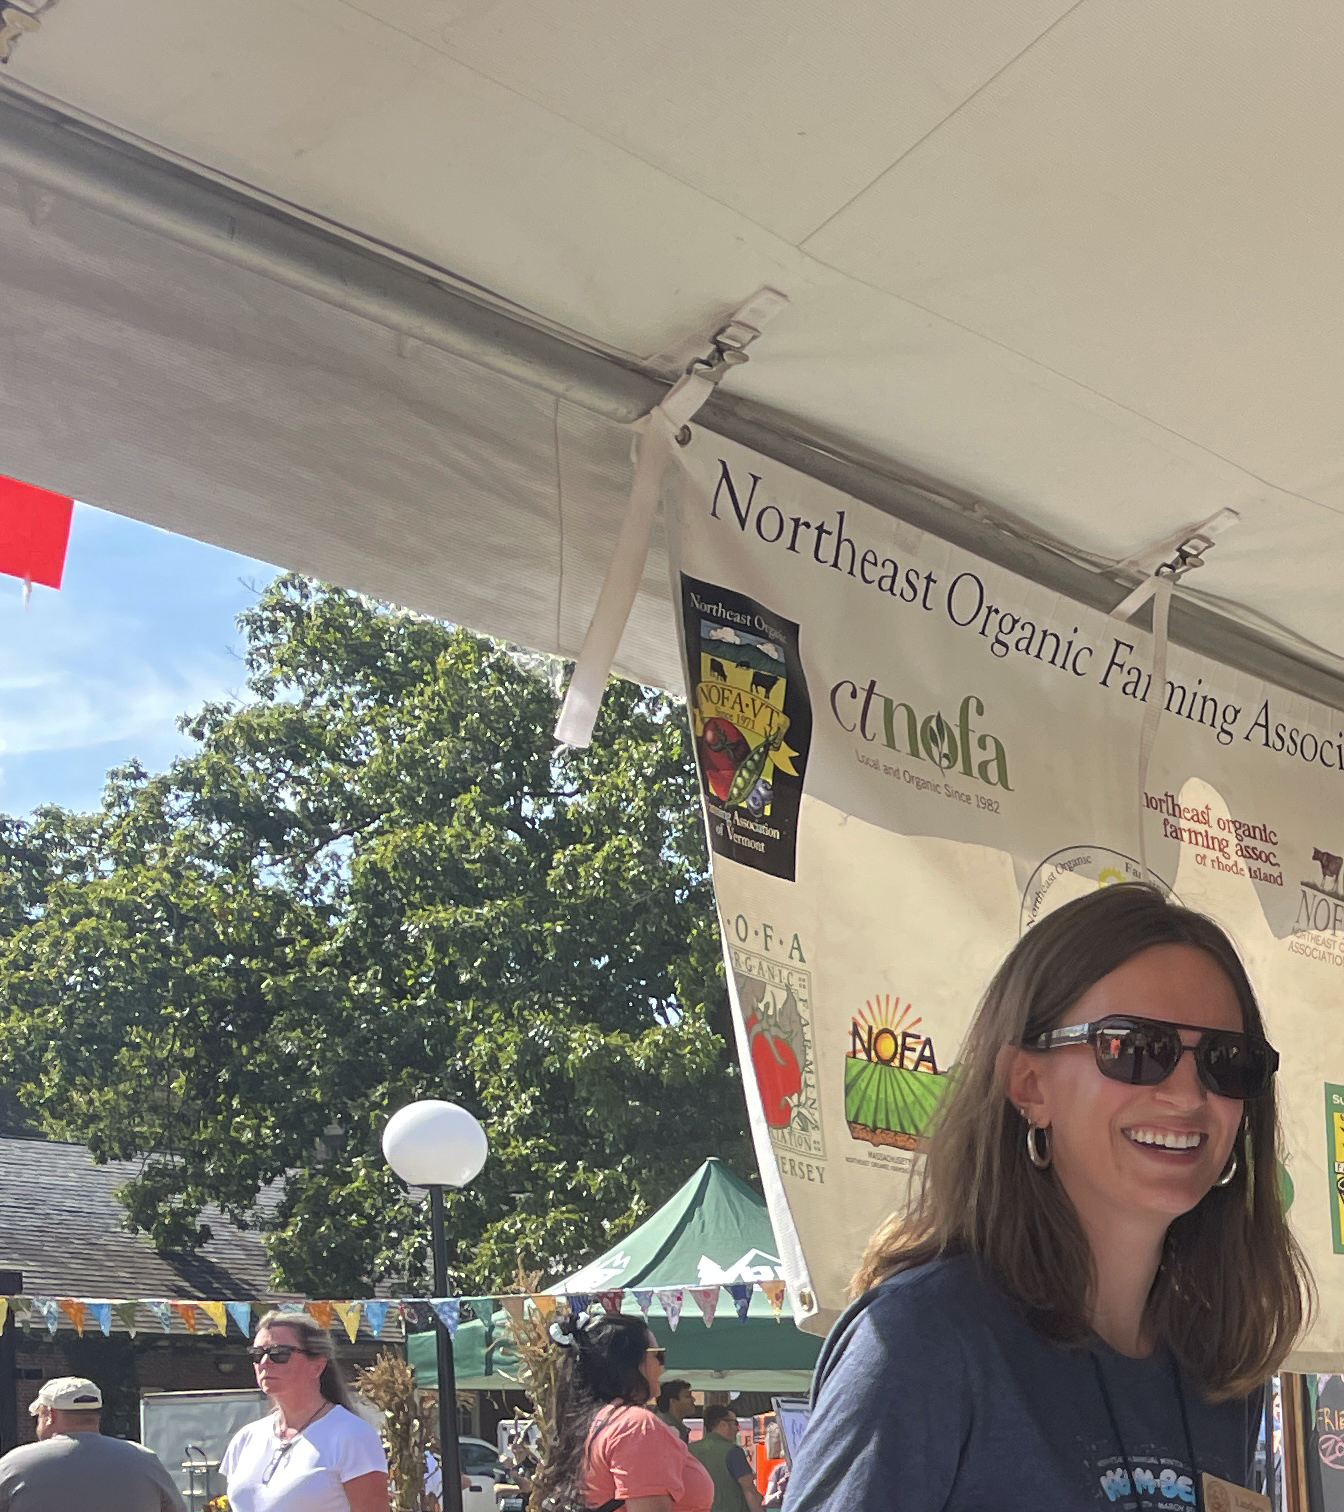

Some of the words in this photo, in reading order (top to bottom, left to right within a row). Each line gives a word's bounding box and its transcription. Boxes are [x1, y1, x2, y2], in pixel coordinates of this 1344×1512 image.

[710, 458, 938, 611] Northeast
[947, 572, 1093, 678] Organic
[690, 591, 751, 627] Northeast
[830, 679, 1015, 792] ctnofa
[883, 763, 901, 781] and
[903, 769, 942, 796] Organic
[944, 782, 972, 806] Since
[974, 793, 1001, 815] 1982
[726, 819, 766, 853] Vermont
[733, 810, 781, 840] Association
[1163, 817, 1229, 860] farming
[1217, 815, 1280, 846] organic
[1195, 852, 1208, 867] of
[1211, 856, 1246, 877] rhode
[1026, 871, 1058, 930] Northeast
[1054, 853, 1092, 876] Organic
[852, 1021, 939, 1075] NOFA
